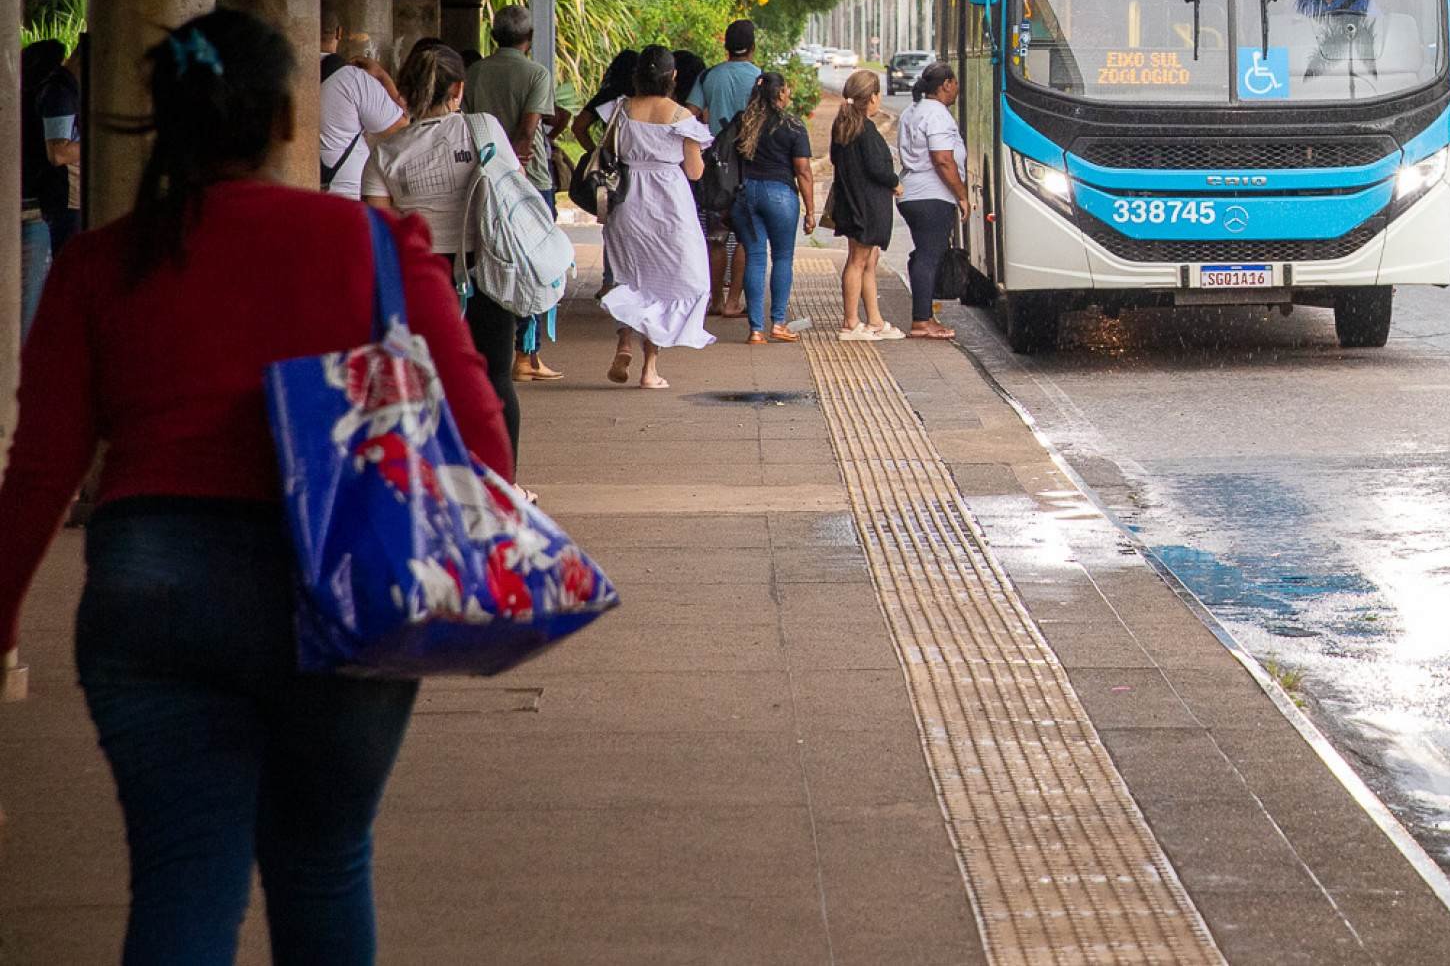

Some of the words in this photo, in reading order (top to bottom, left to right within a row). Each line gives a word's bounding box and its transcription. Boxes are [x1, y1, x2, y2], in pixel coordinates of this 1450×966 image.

[1106, 51, 1145, 68] EIXO
[1151, 51, 1182, 68] SUL
[1112, 199, 1217, 225] 338745
